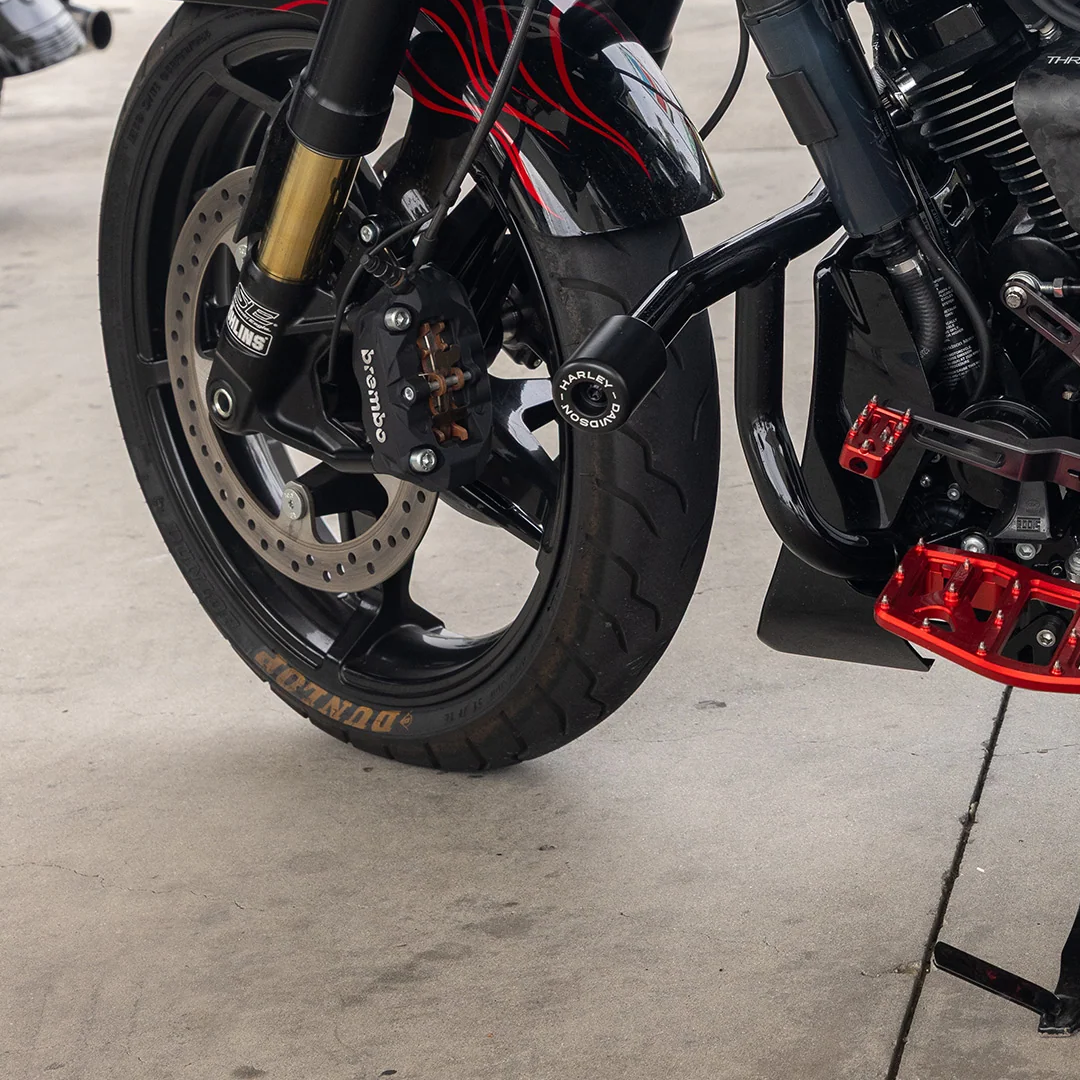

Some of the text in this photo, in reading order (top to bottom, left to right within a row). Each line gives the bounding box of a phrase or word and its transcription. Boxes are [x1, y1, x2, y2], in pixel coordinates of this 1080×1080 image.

[361, 349, 386, 443] brembo
[560, 371, 613, 391] HARLEY
[561, 403, 620, 428] DAVIDSON
[254, 650, 401, 733] DUNLOP
